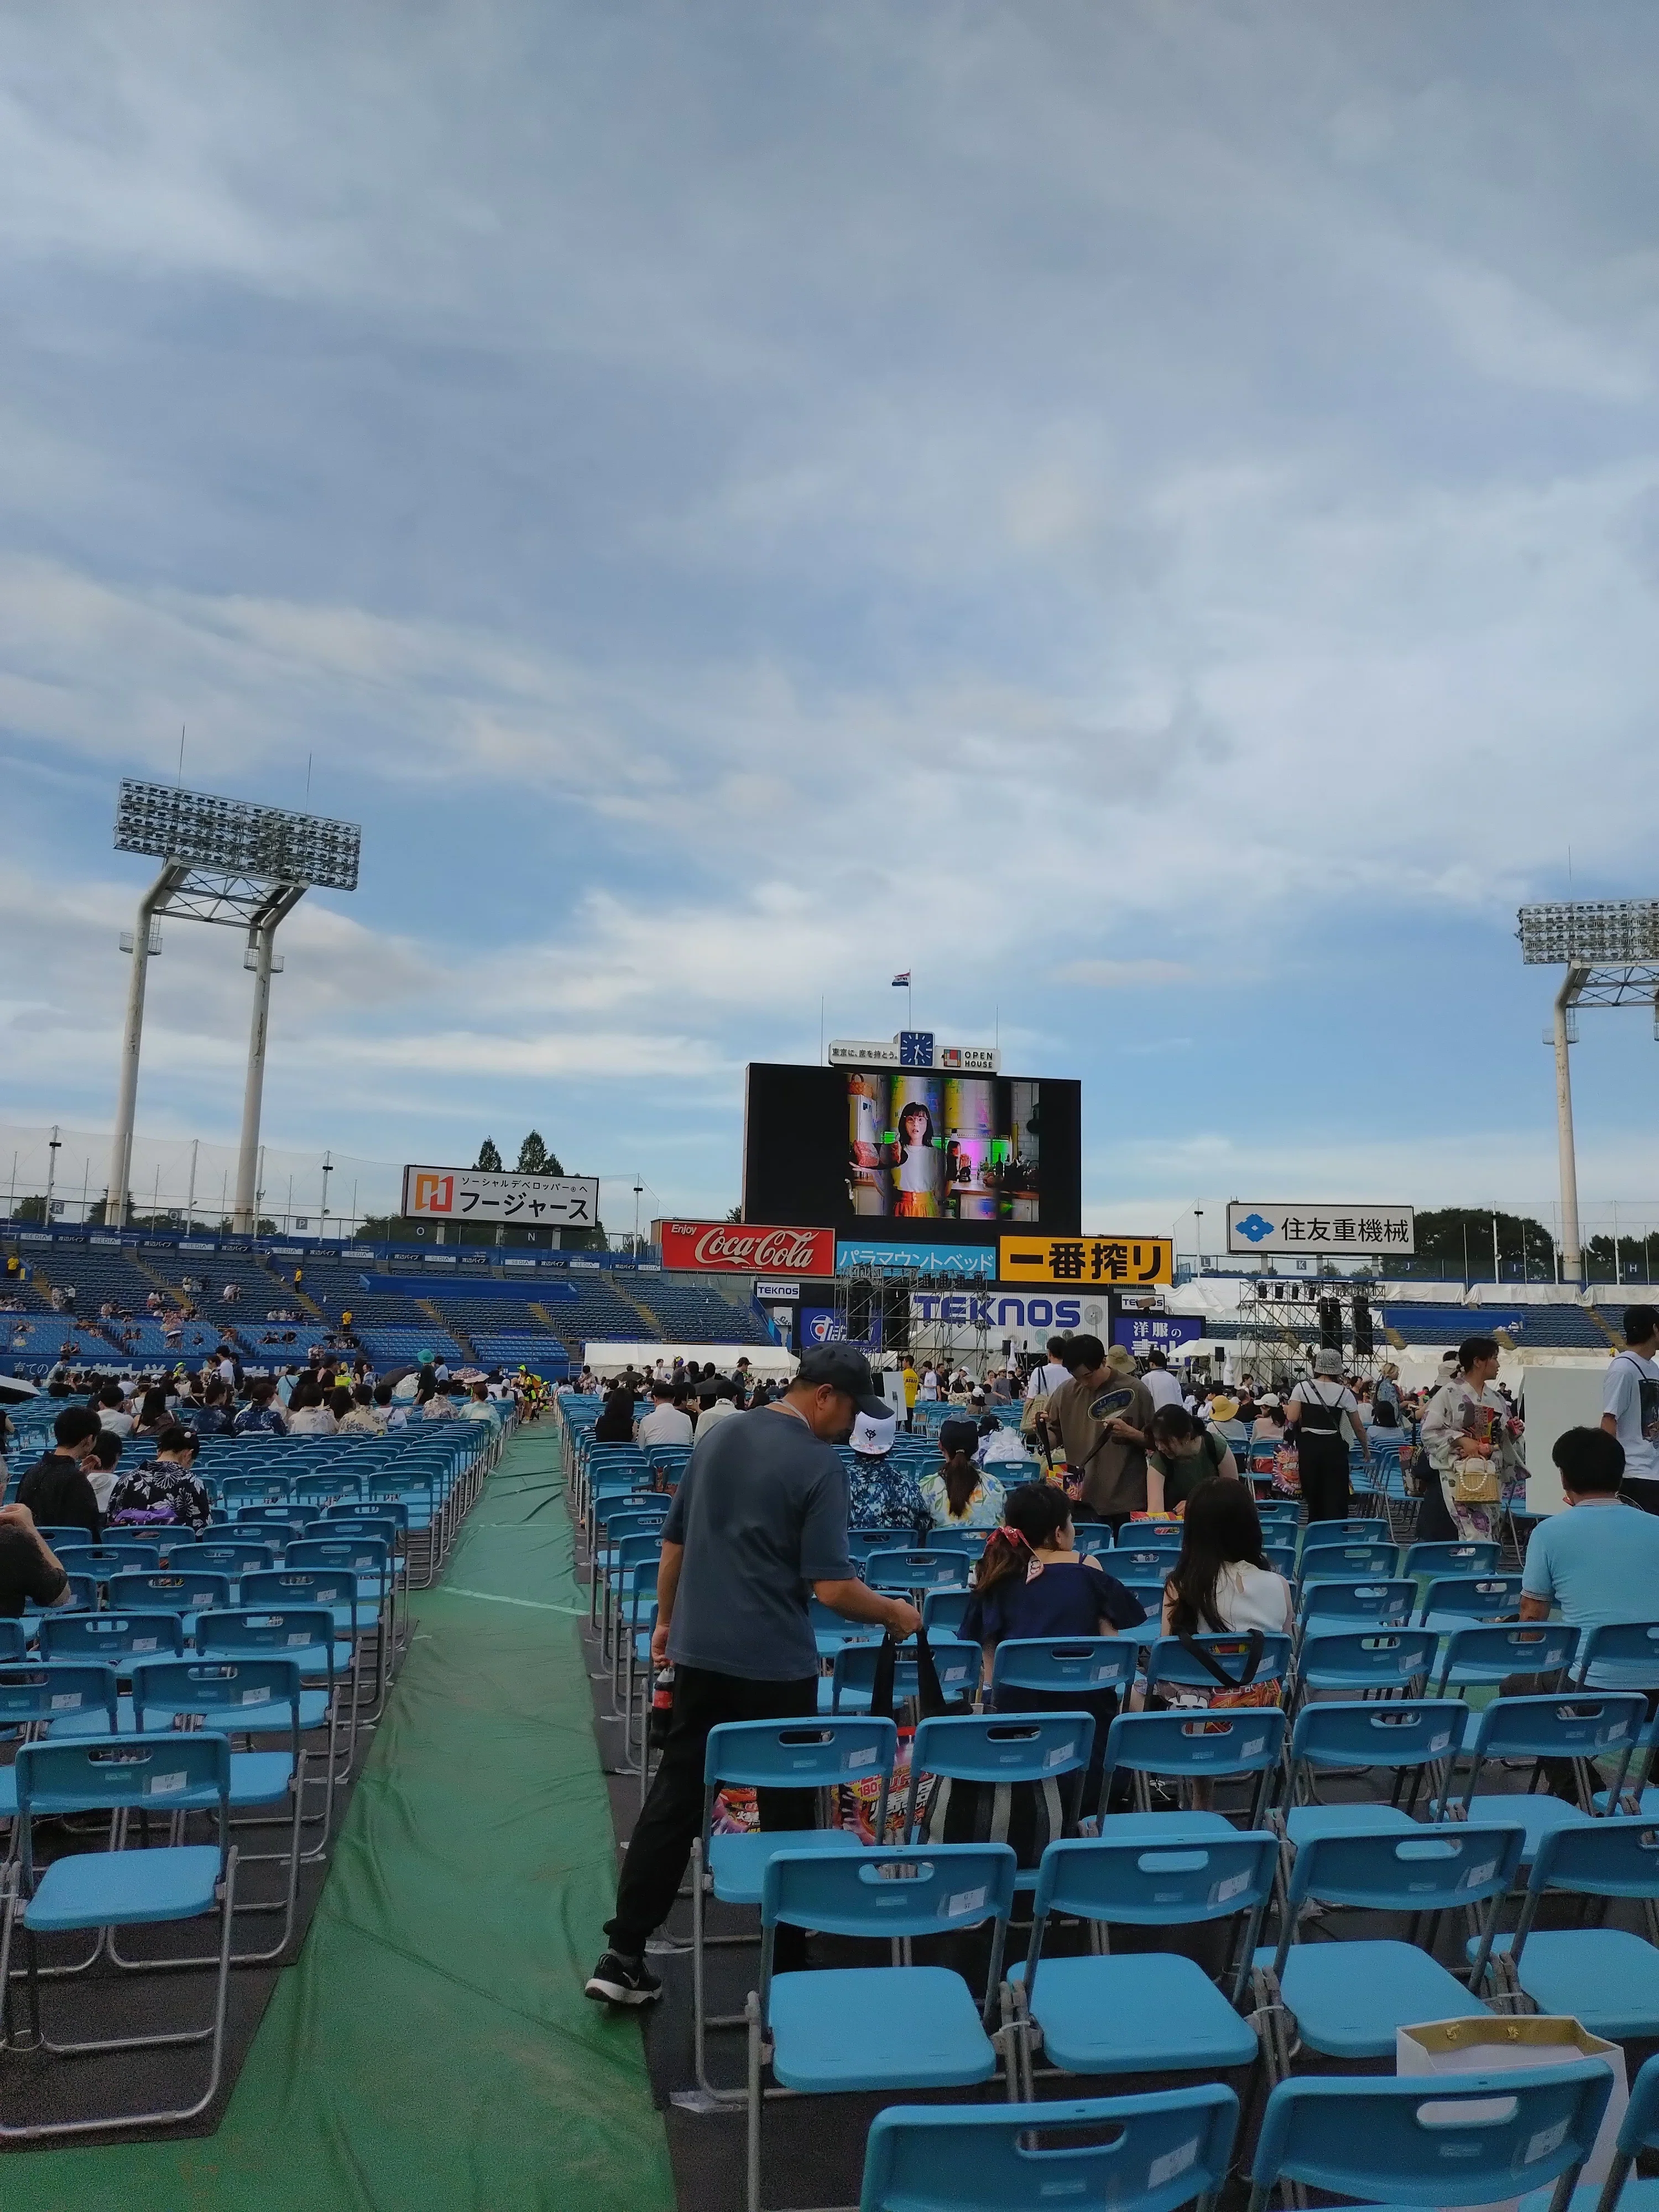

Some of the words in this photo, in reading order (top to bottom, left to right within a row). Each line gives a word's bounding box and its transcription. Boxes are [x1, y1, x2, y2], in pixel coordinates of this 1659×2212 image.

[964, 1051, 993, 1060] OPEN
[54, 1203, 62, 1213] R
[460, 1192, 589, 1220] フージャース
[169, 1211, 179, 1220] Q
[299, 1220, 305, 1229] P
[671, 1224, 697, 1235] Enjoy
[1281, 1217, 1409, 1243] 住友重機械
[528, 1232, 535, 1241] N
[623, 1237, 633, 1245] M
[695, 1227, 820, 1268] Coca-Cola
[839, 1249, 994, 1271] パラマウントベッド
[1010, 1242, 1161, 1281] 一番搾り
[1203, 1256, 1209, 1267] L
[1298, 1260, 1306, 1270] K
[1629, 1264, 1637, 1272] H
[758, 1286, 799, 1295] TEKNOS
[1123, 1298, 1164, 1307] TES
[914, 1295, 1081, 1328] TEKNOS
[1134, 1321, 1182, 1338] 洋服の
